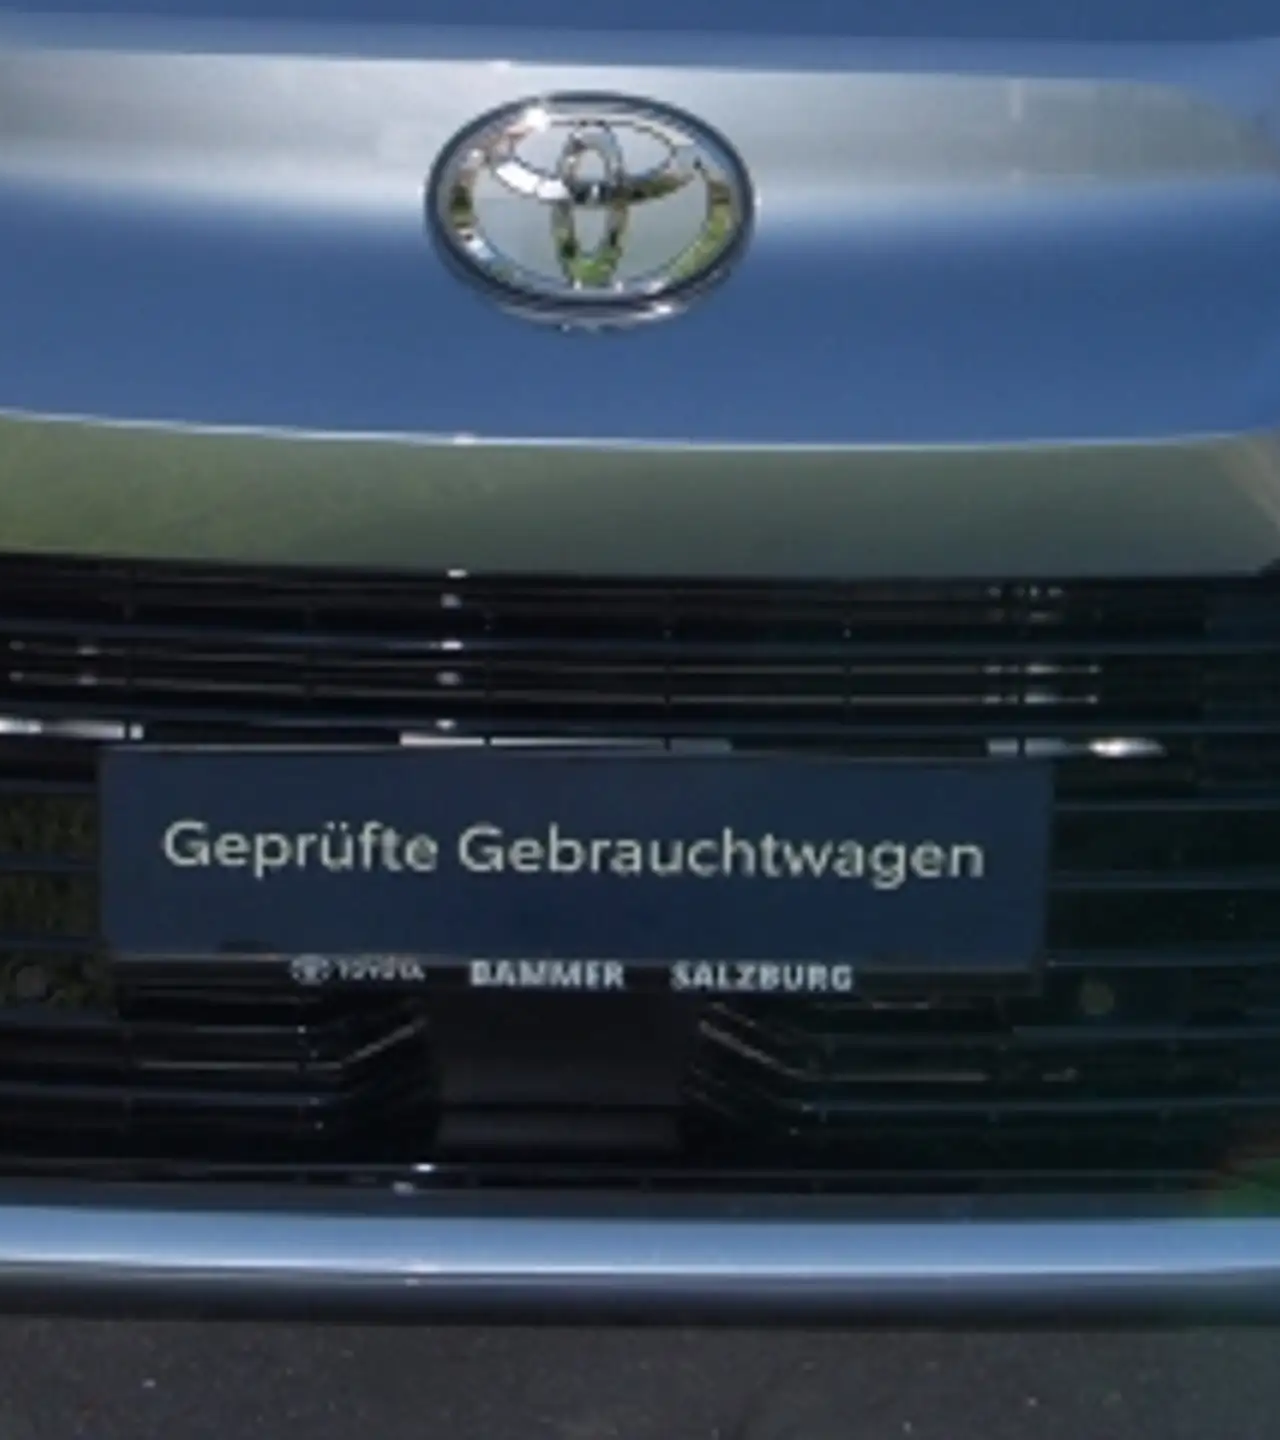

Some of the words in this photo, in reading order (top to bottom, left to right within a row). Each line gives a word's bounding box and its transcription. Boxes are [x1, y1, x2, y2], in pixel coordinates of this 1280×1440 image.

[163, 819, 439, 881] Geprüfte
[457, 822, 985, 891] Gebrauchtwagen
[469, 959, 625, 988] BAMMER
[670, 960, 855, 991] SALZBURG
